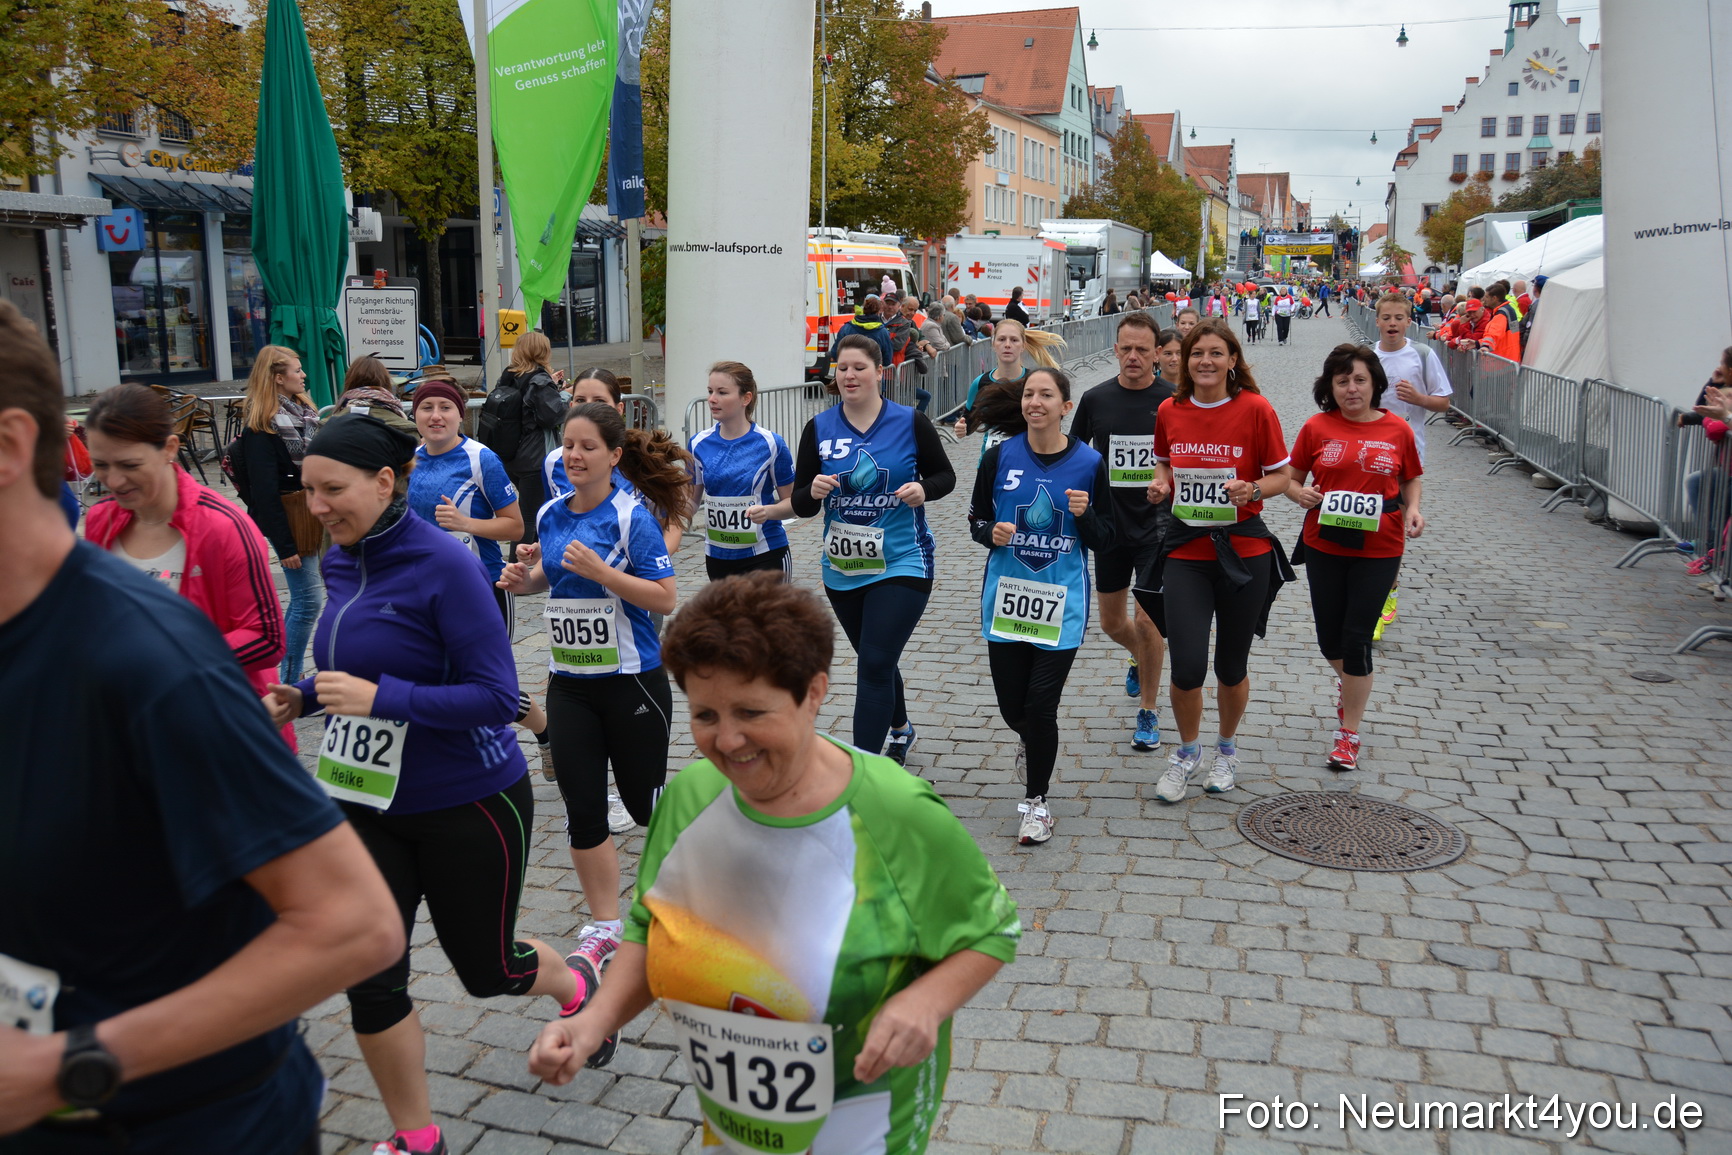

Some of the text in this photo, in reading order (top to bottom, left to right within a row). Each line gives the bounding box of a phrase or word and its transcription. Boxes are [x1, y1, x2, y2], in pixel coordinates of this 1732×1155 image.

[495, 47, 586, 77] Verantwortung
[514, 57, 606, 91] Genuss schaffen
[149, 149, 179, 173] City
[361, 228, 374, 236] Mode
[669, 242, 783, 255] www.bmw-laufsport.de
[348, 297, 414, 306] Fußgänger Richtung
[360, 307, 403, 315] Lammsbräu-
[357, 317, 390, 326] Kreuzung
[361, 338, 405, 347] Kaserngasse
[819, 438, 852, 460] 45
[1170, 443, 1231, 456] NEUMARKT
[1114, 448, 1158, 468] 5125
[1003, 469, 1024, 491] 5
[1121, 472, 1153, 480] Andreas
[1180, 481, 1230, 505] 5043
[1327, 493, 1377, 516] 5063
[1191, 509, 1214, 519] Anita
[1335, 517, 1362, 529] Christa
[720, 534, 740, 544] Sonja
[843, 529, 873, 538] Neumarkt
[829, 535, 878, 559] 5013
[1019, 550, 1053, 559] BASKETS
[843, 560, 864, 569] Julia
[999, 582, 1055, 597] PARTL Neumarkt
[545, 606, 565, 614] PARTL
[1001, 593, 1059, 623] 5097
[550, 617, 609, 645] 5059
[1013, 622, 1039, 636] Maria
[561, 651, 603, 664] Franziska
[327, 716, 394, 768] 5182
[330, 766, 364, 788] Heike
[672, 1012, 799, 1052] PARTL Neumarkt
[689, 1037, 816, 1113] 5132
[718, 1110, 784, 1149] Christa
